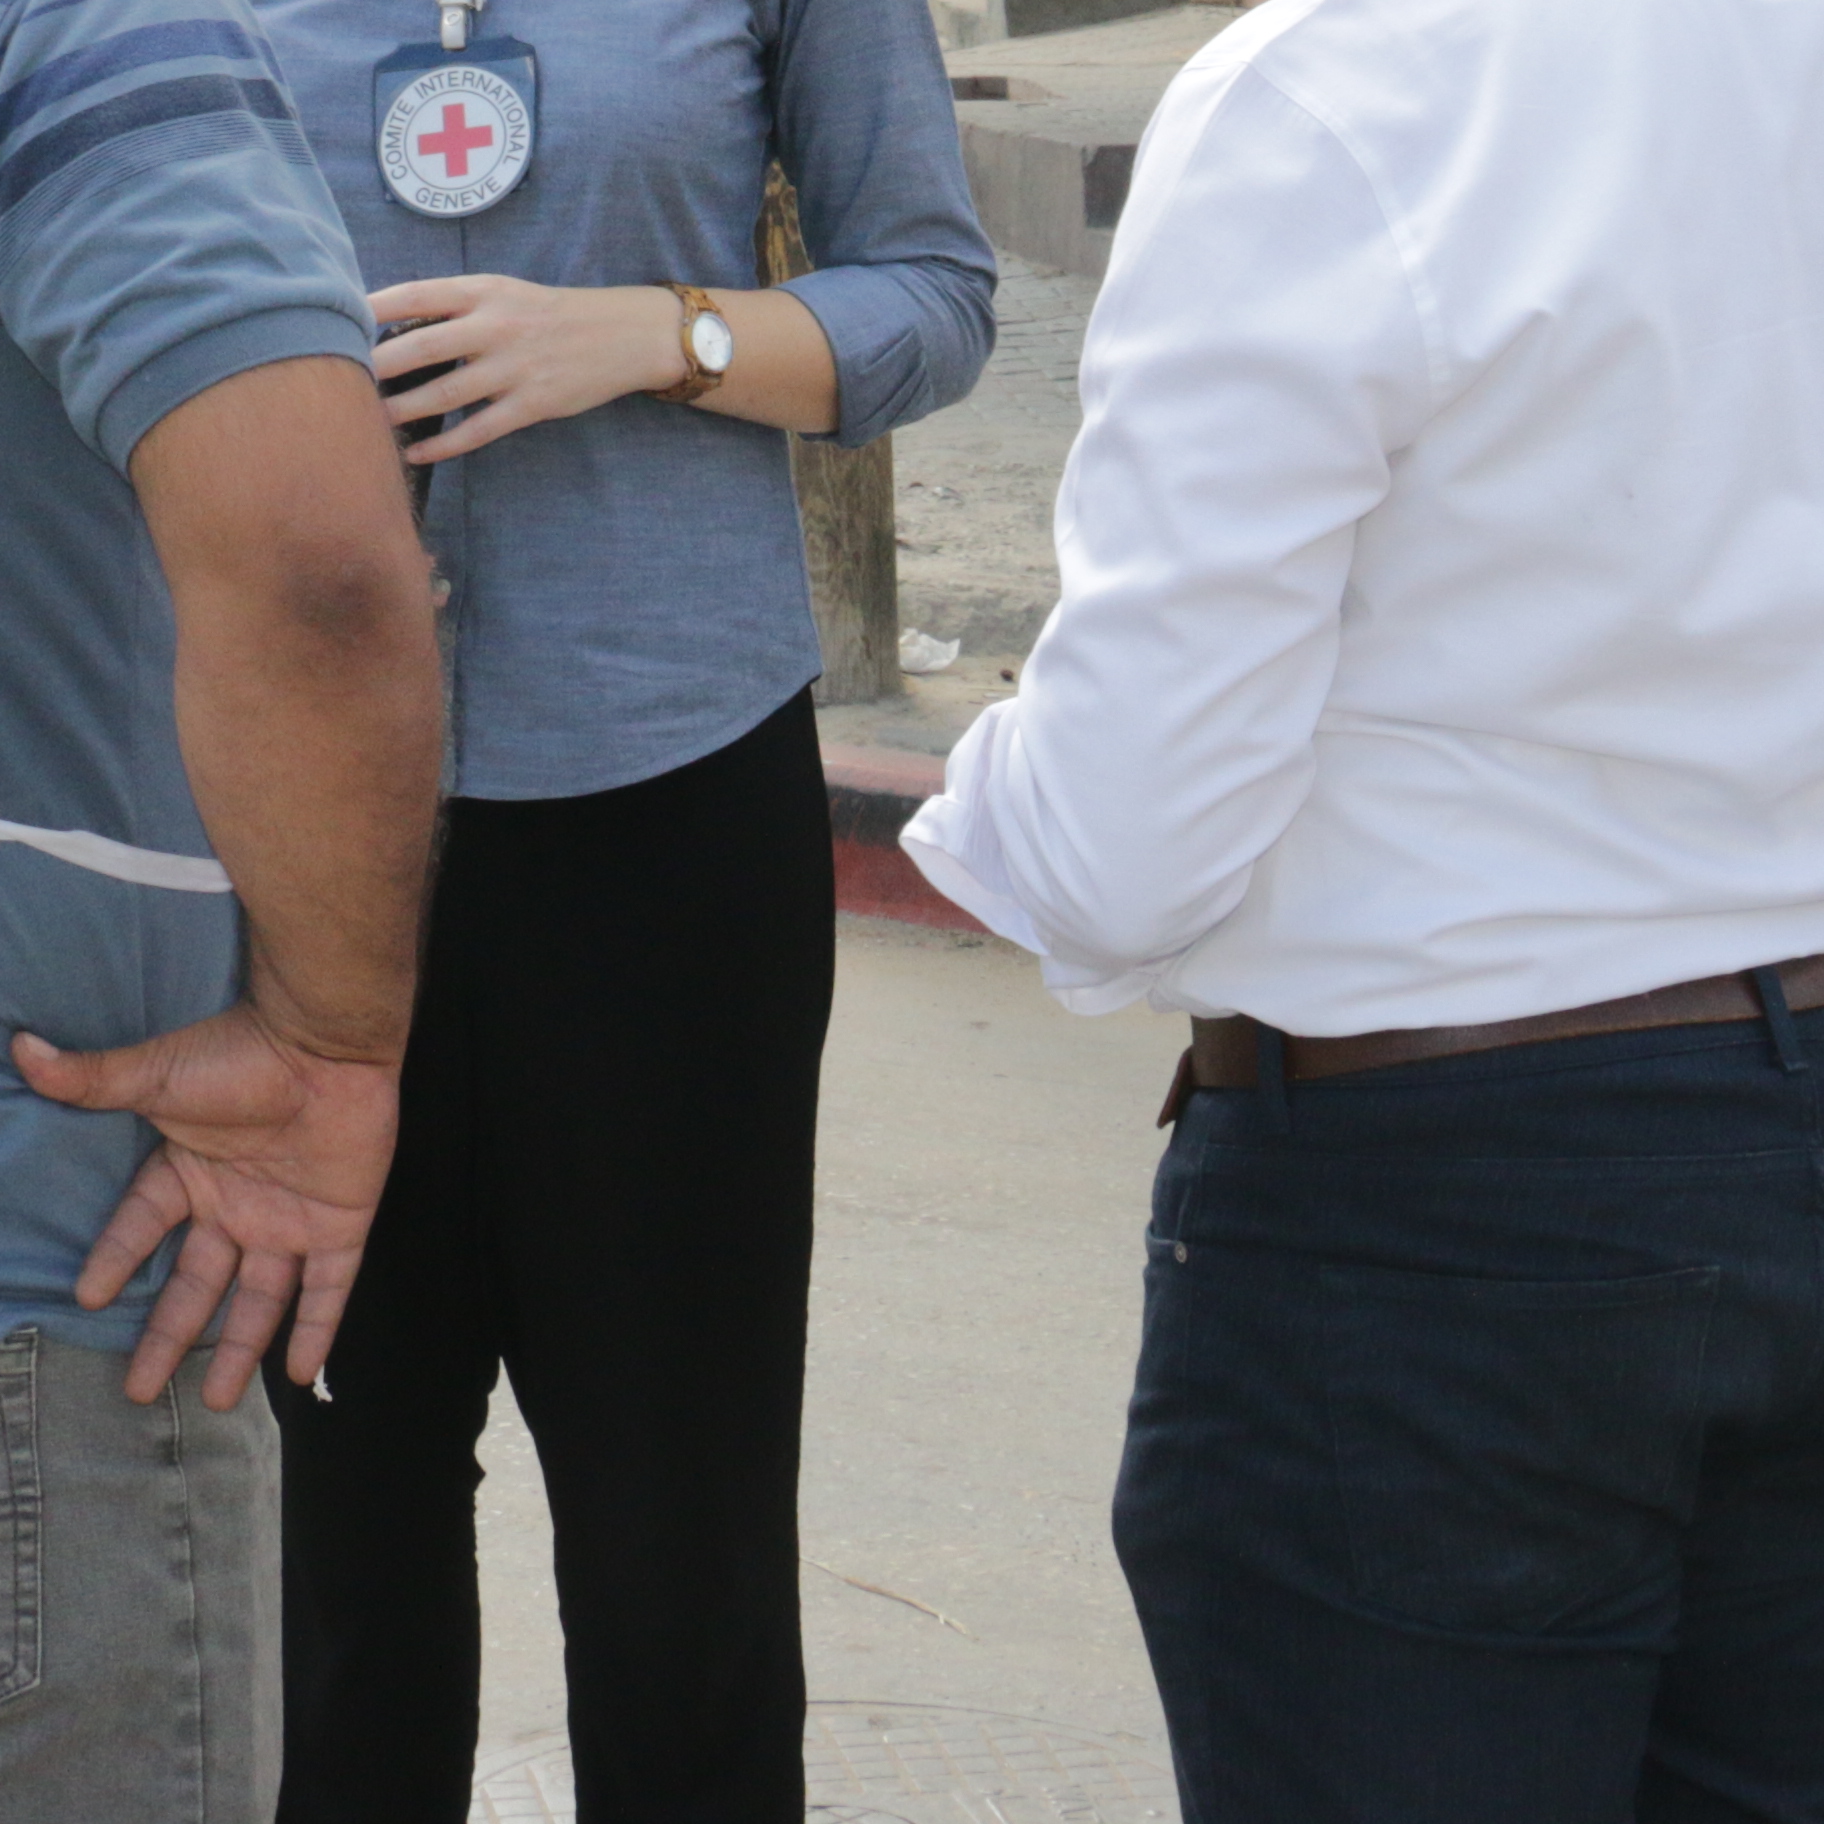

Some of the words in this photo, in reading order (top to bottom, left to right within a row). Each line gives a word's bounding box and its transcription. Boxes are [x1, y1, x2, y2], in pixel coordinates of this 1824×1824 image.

[386, 100, 413, 180] COMITE
[415, 70, 526, 165] INTERNATIONAL
[415, 177, 501, 209] GENEVE
